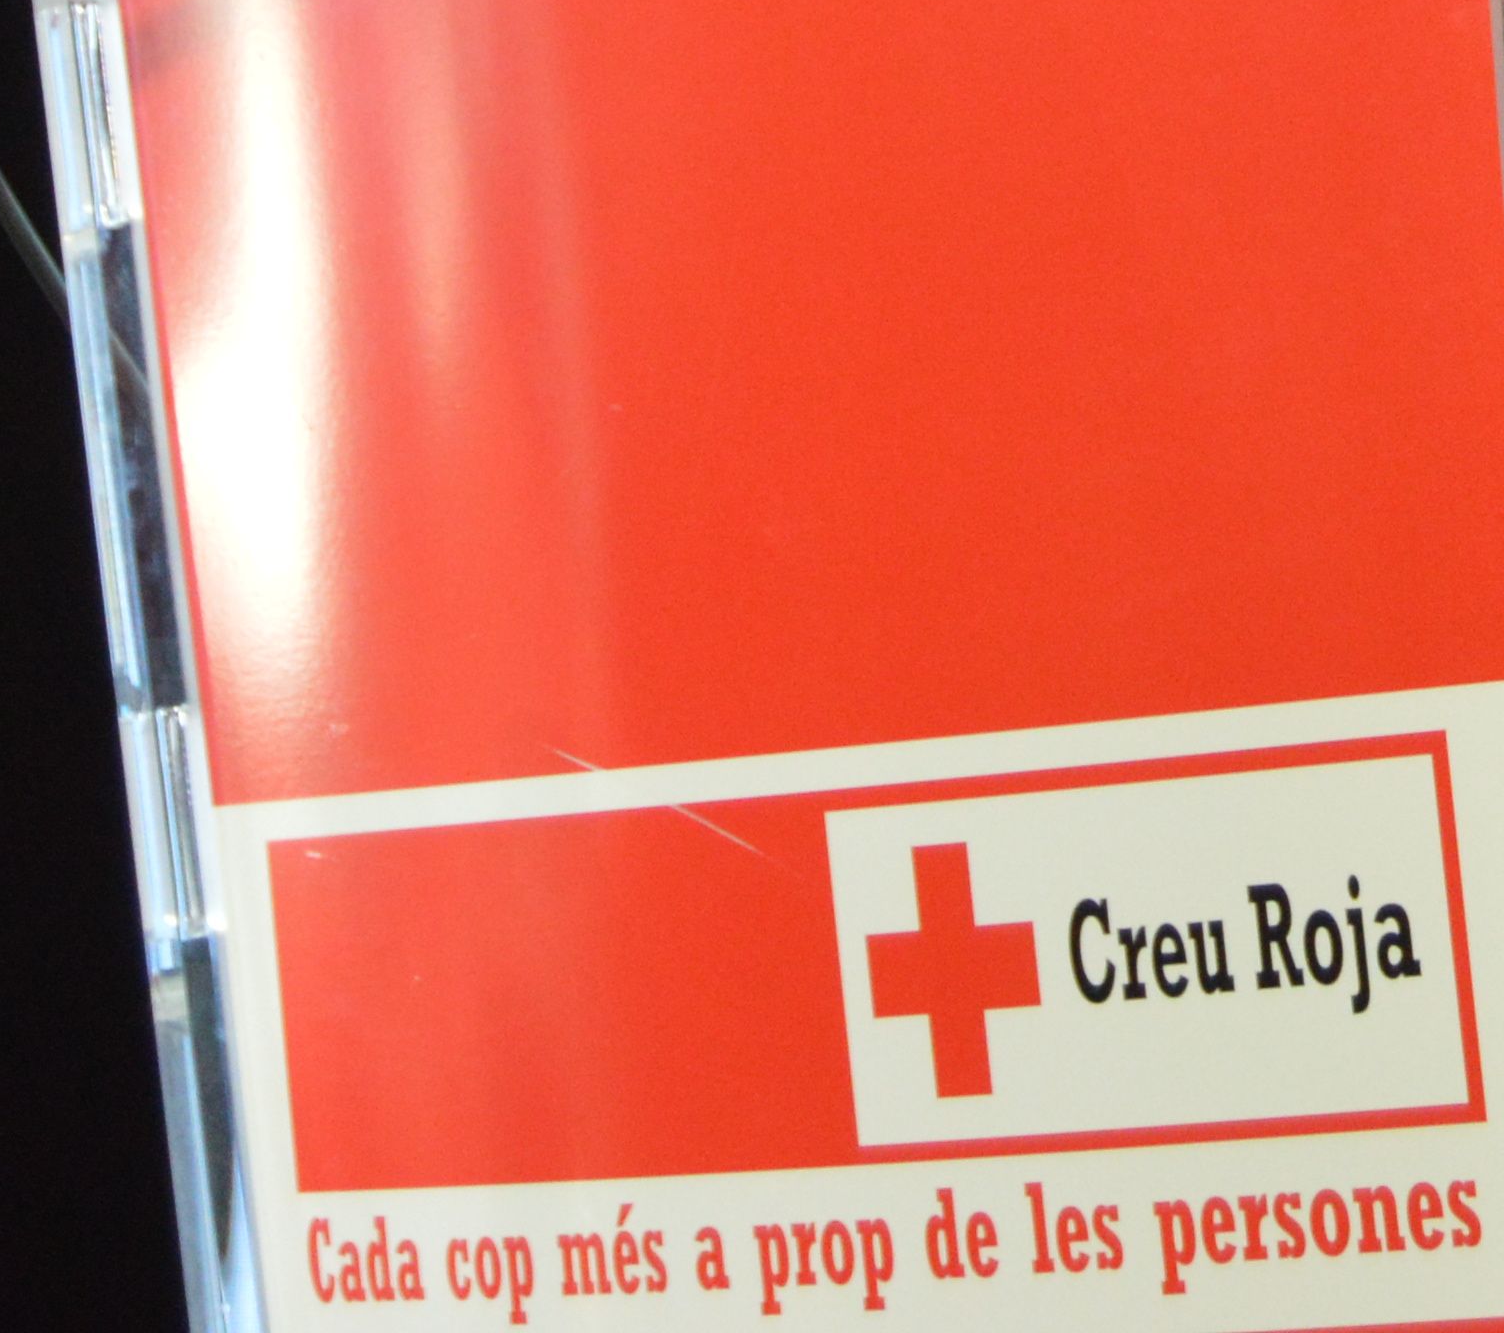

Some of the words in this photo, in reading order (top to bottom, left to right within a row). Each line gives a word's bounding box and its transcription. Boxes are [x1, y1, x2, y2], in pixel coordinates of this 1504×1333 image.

[1068, 897, 1235, 1004] Creu
[1247, 875, 1422, 1014] Roja
[308, 1216, 426, 1303] Cada
[447, 1236, 535, 1325] cop
[558, 1203, 669, 1297] més
[695, 1226, 731, 1291] a
[754, 1218, 895, 1317] prop
[926, 1187, 1000, 1280] de
[1024, 1181, 1125, 1274] les
[1154, 1176, 1483, 1296] persones
